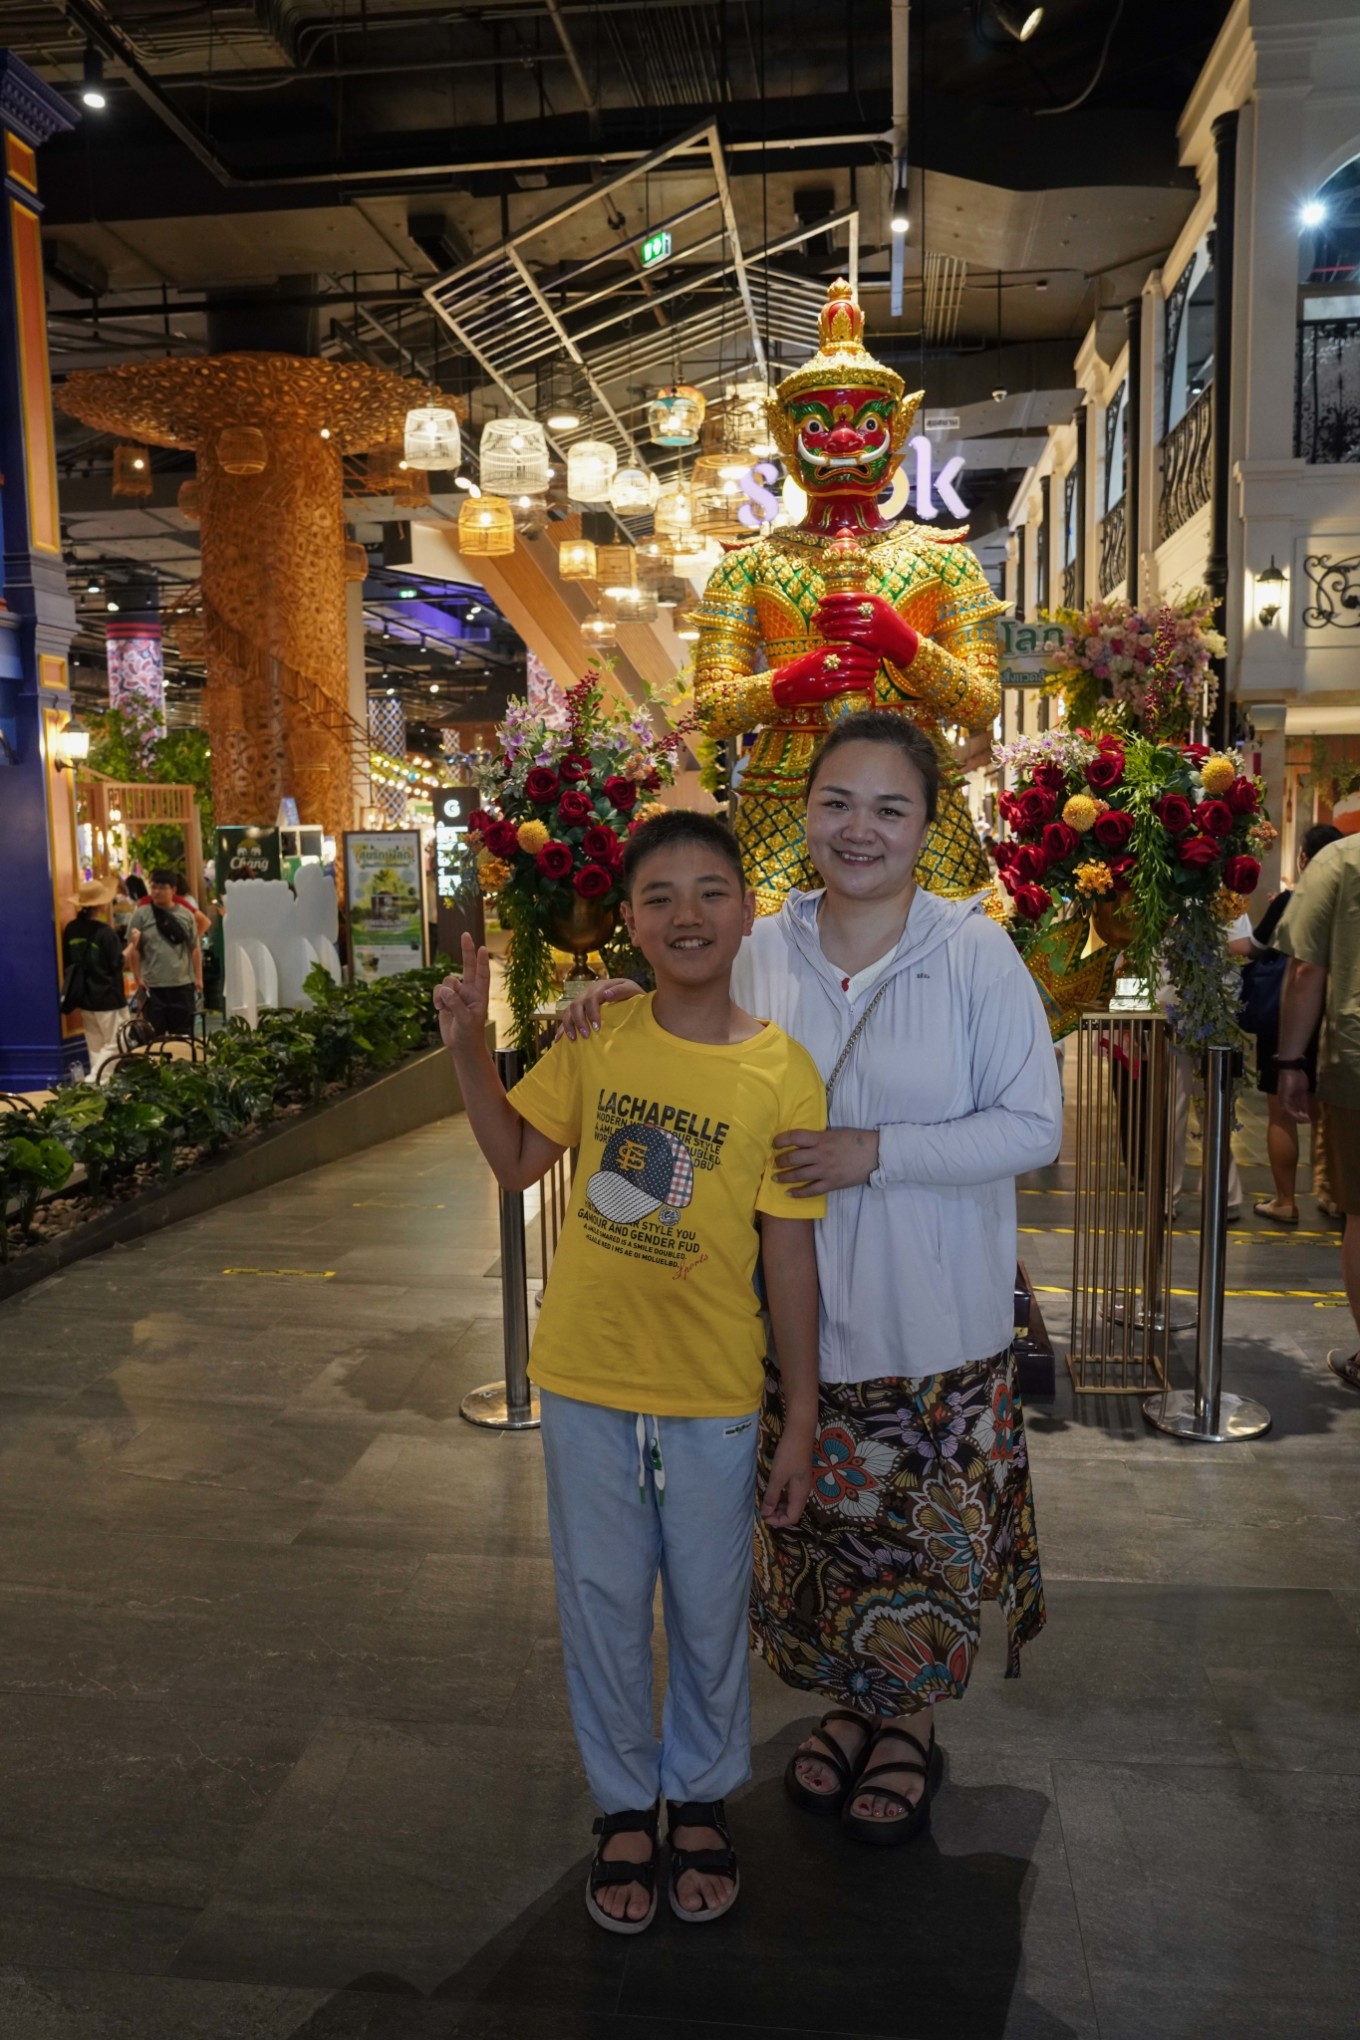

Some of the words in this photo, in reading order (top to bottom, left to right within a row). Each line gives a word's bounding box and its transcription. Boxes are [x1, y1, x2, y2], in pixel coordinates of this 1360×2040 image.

[443, 799, 461, 818] G
[230, 856, 269, 872] Chang
[597, 1088, 730, 1146] LACHAPELLE
[693, 1138, 721, 1155] STYLE
[608, 1223, 629, 1237] AND
[630, 1229, 675, 1249] GENDER
[678, 1241, 700, 1254] FUD
[641, 1221, 673, 1237] STYLE
[676, 1228, 696, 1241] YOU
[633, 1242, 653, 1253] SMILE
